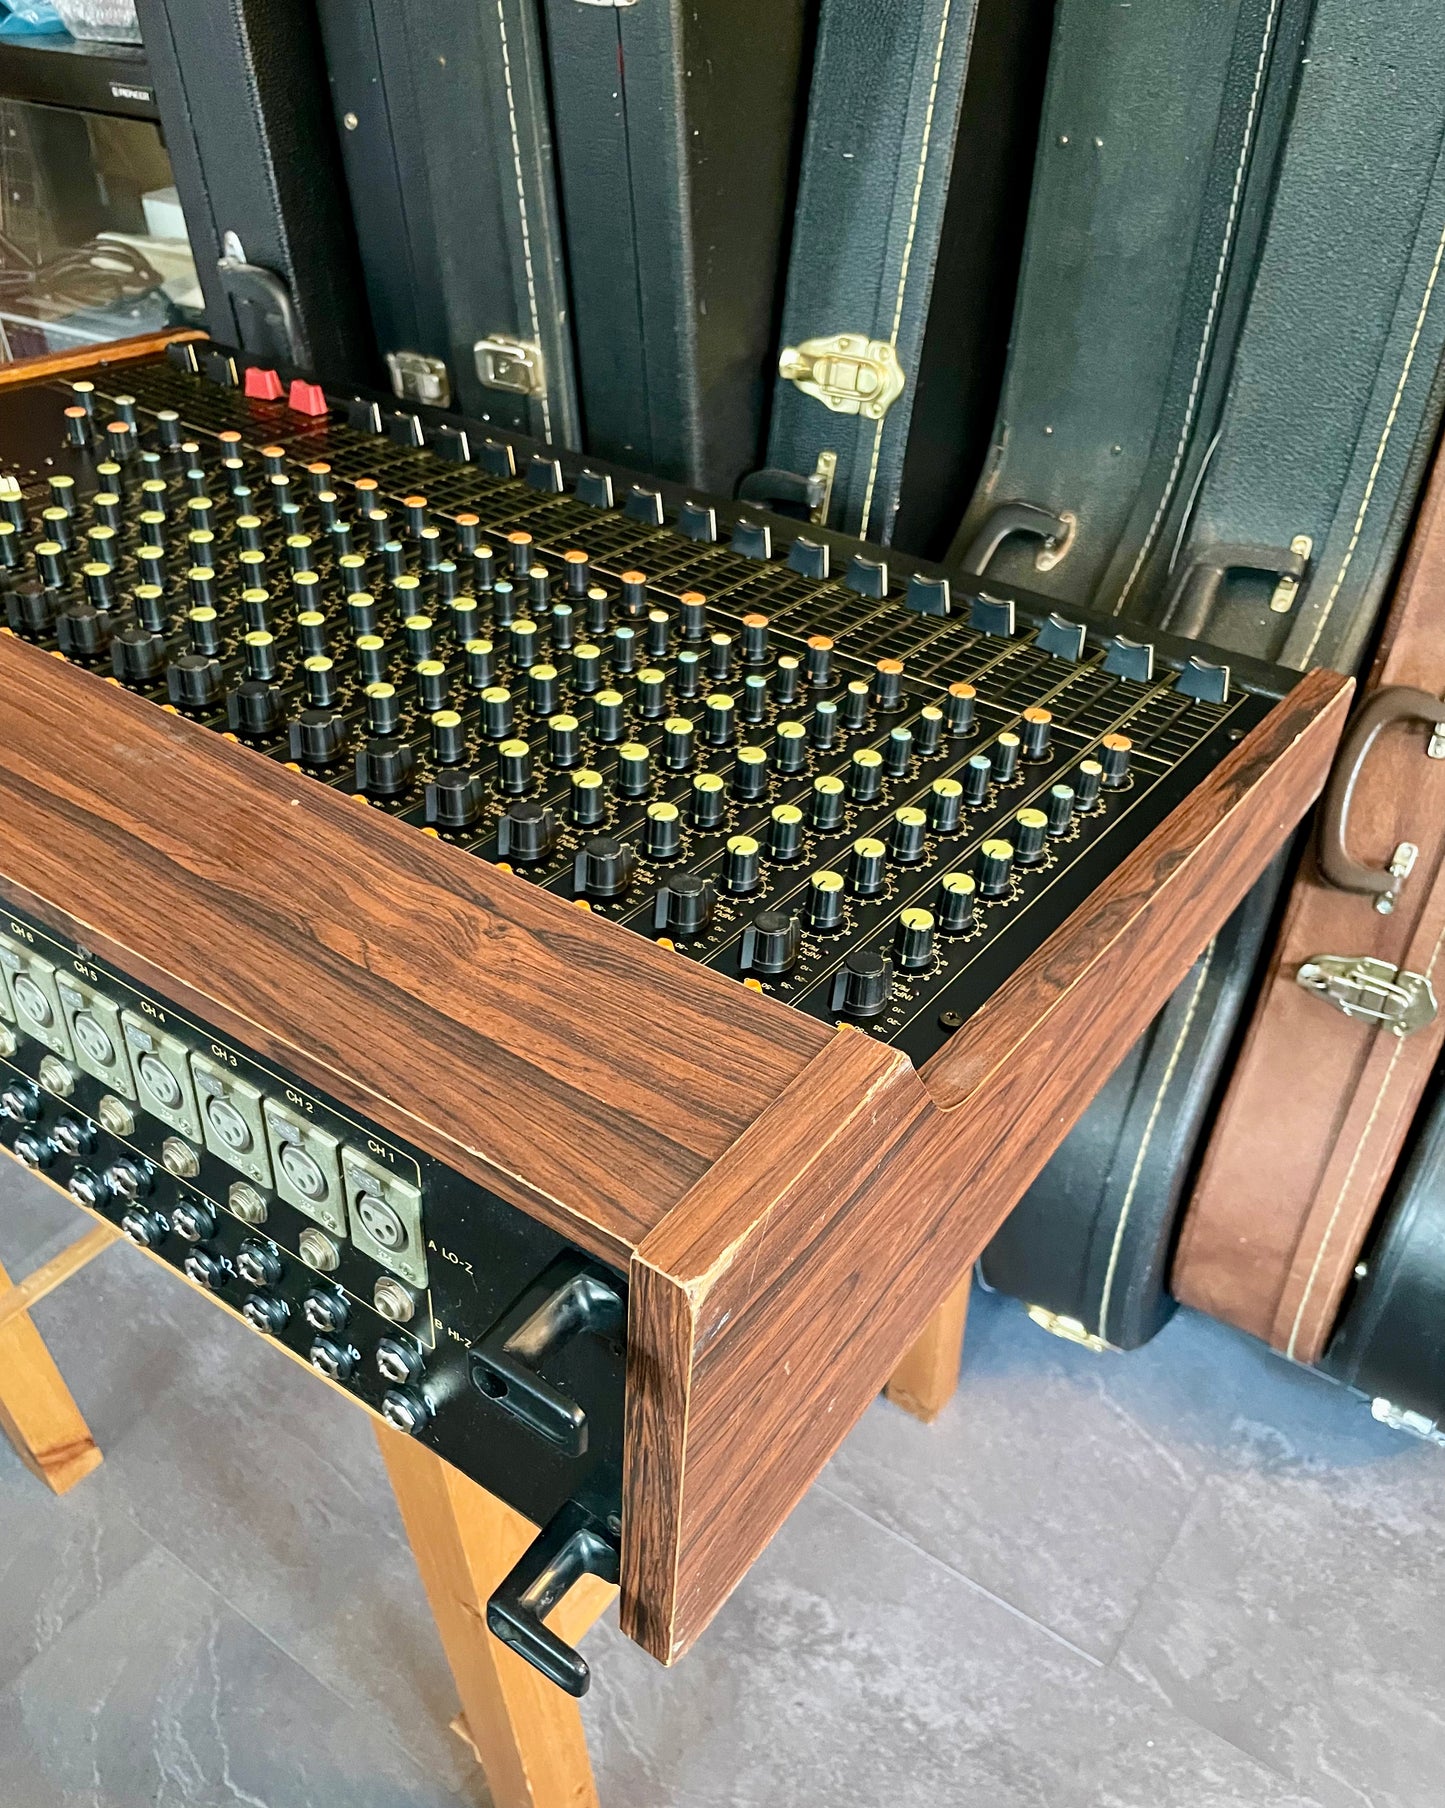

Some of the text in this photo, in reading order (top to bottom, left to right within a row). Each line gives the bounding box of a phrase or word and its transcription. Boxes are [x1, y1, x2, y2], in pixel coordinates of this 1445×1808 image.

[11, 922, 25, 937] CH
[74, 960, 98, 982] CH 5
[140, 1001, 166, 1023] CH 4
[211, 1044, 238, 1067] CH 3
[286, 1089, 314, 1114] CH 2
[367, 1139, 395, 1163] CH 1
[203, 1197, 217, 1219] 4
[267, 1240, 280, 1257] 3
[427, 1239, 474, 1275] A LO-Z
[334, 1283, 351, 1306] 2
[434, 1317, 473, 1349] B HI-Z
[424, 1394, 437, 1417] 9
